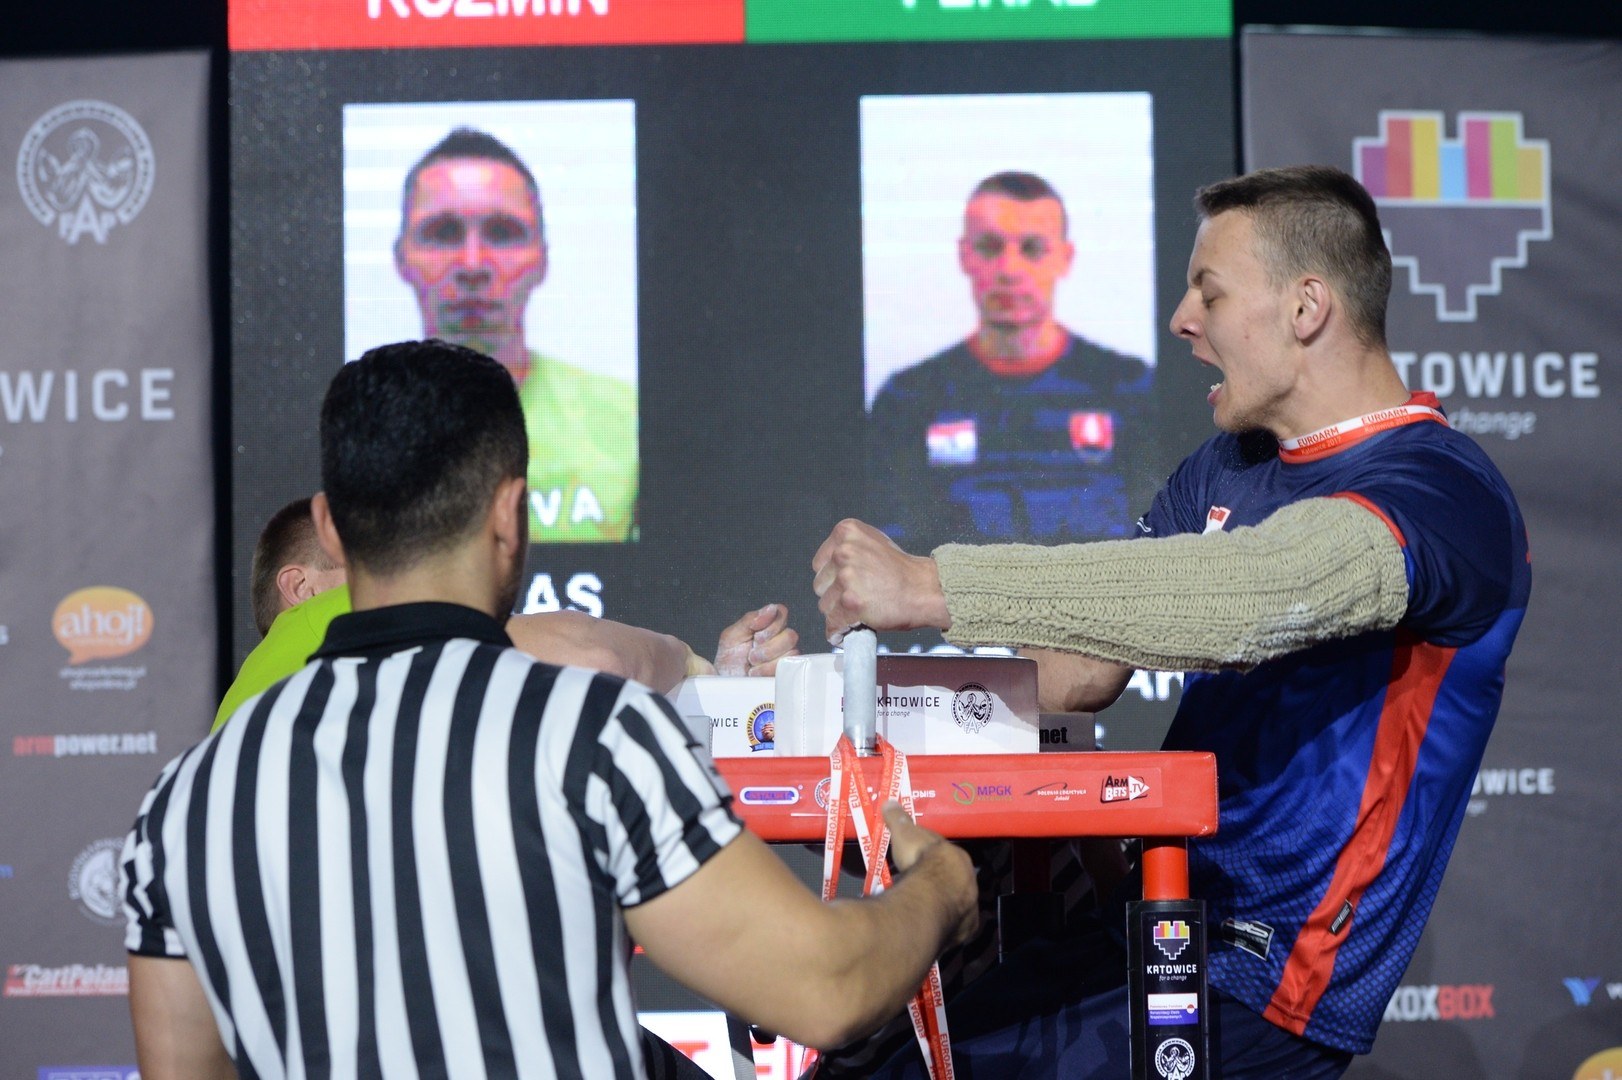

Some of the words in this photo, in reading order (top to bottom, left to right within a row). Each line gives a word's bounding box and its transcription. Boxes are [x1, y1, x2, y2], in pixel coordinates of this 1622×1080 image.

[1390, 351, 1602, 399] TOWICE
[0, 367, 175, 423] WICE
[1361, 408, 1409, 425] EUROARM
[1297, 427, 1339, 448] EUROARM
[529, 485, 605, 528] VA
[59, 603, 146, 646] ahoj!
[877, 696, 940, 708] KATOWICE
[890, 710, 910, 718] change
[712, 717, 739, 728] WICE
[1040, 726, 1068, 744] net
[1105, 775, 1129, 788] ARM
[976, 784, 1012, 796] MPGK
[1105, 787, 1127, 802] BETS
[827, 799, 839, 851] EUROARM
[1146, 963, 1198, 975] KATOWICE
[1171, 974, 1188, 982] change
